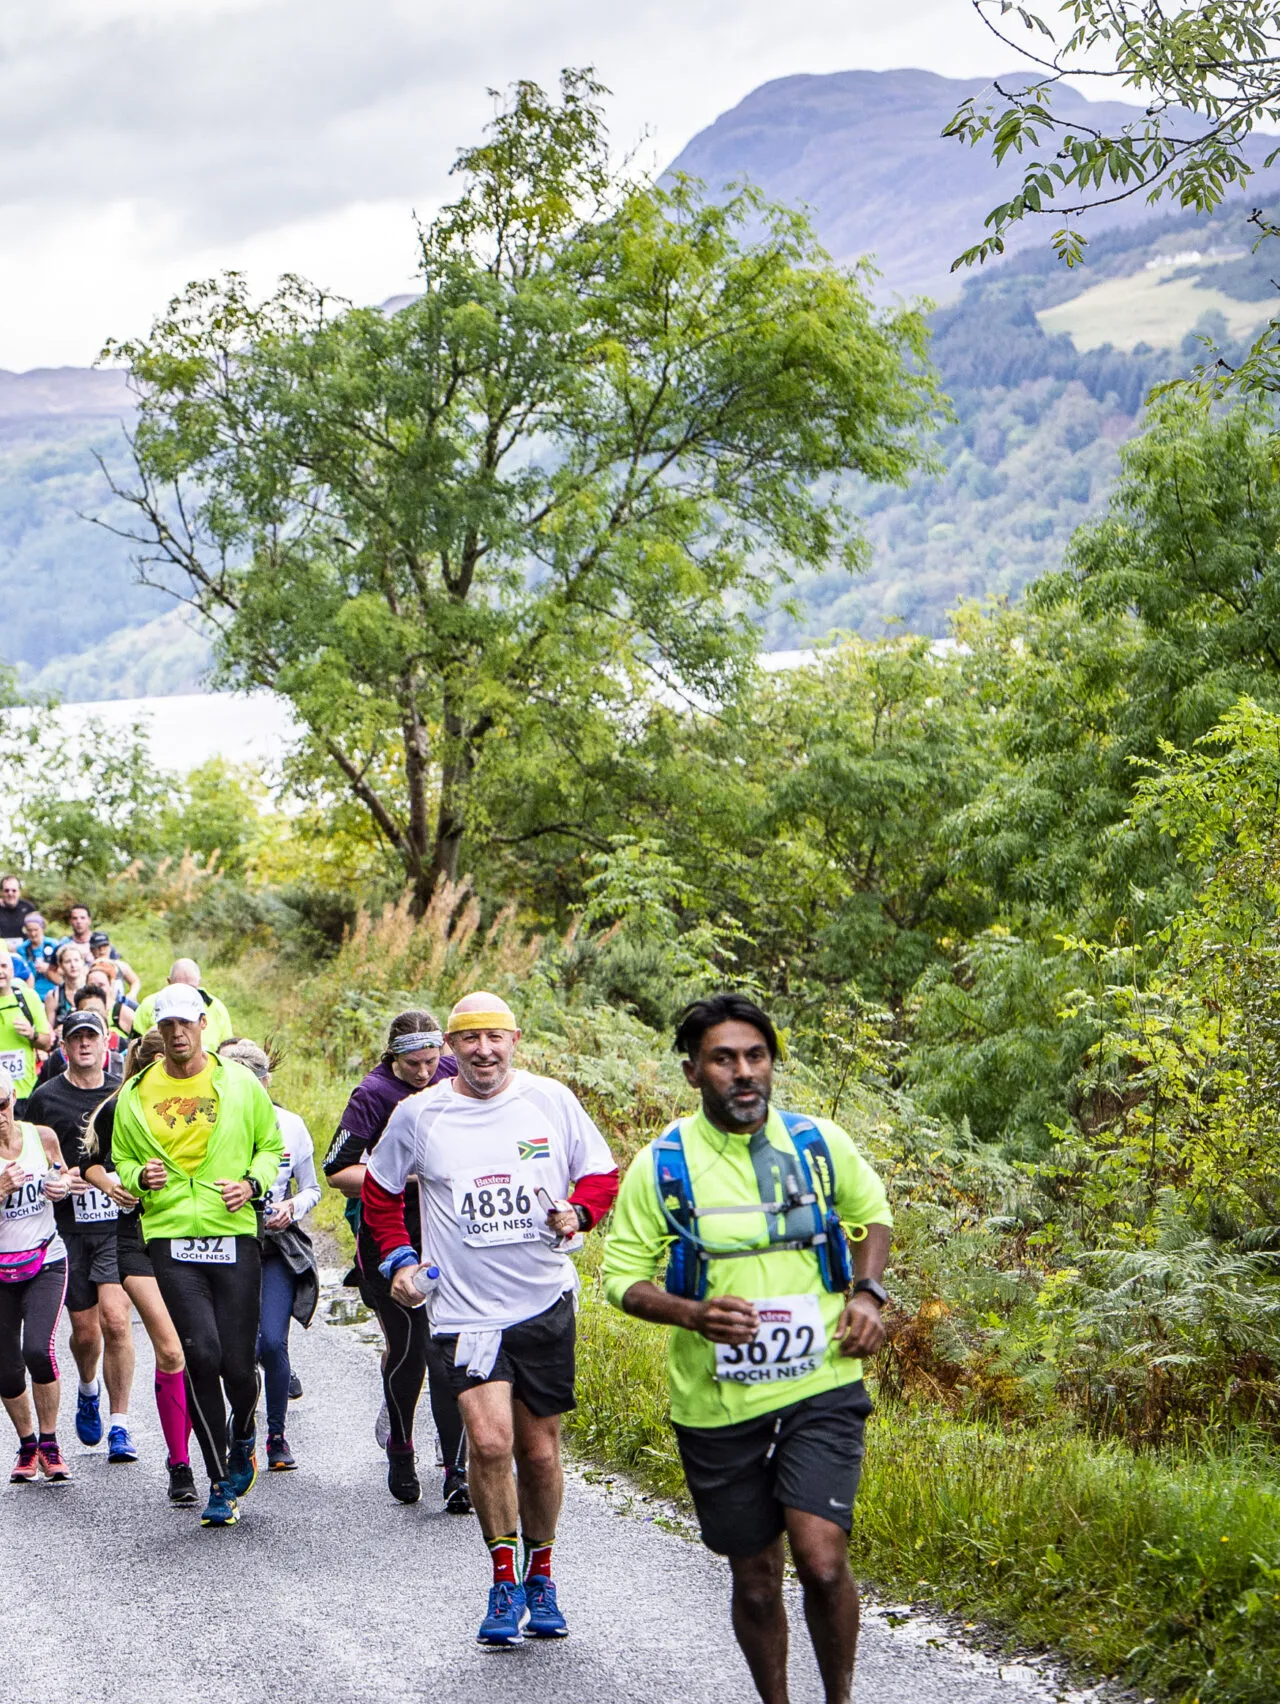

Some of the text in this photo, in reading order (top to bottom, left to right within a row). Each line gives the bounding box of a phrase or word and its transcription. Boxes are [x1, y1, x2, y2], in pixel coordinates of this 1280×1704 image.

[476, 1174, 511, 1188] Baxters
[77, 1190, 112, 1211] 413
[461, 1185, 531, 1220] 4836
[6, 1207, 30, 1219] LOCH
[104, 1209, 119, 1218] NES
[467, 1218, 533, 1235] LOCH NESS
[176, 1252, 202, 1260] LOCH
[723, 1326, 814, 1365] 3622
[726, 1358, 817, 1381] LOCH NESS
